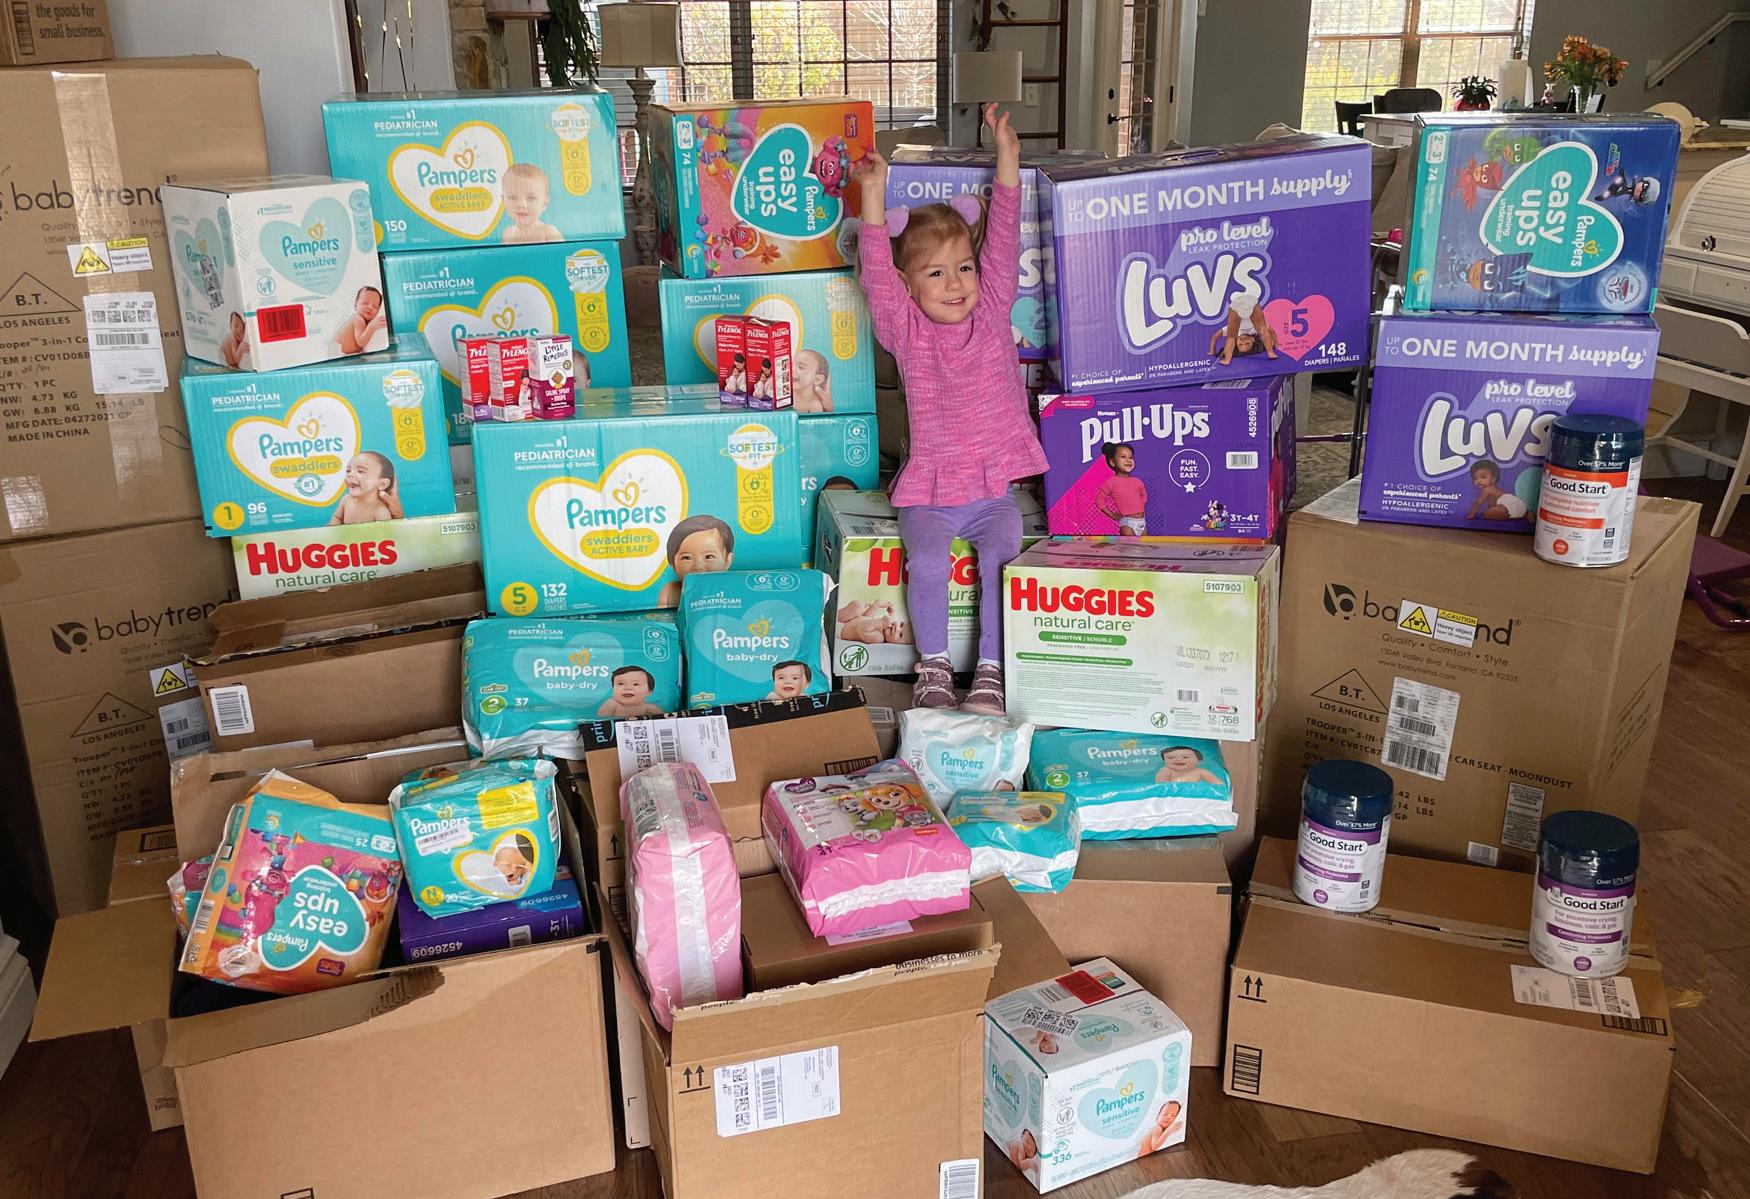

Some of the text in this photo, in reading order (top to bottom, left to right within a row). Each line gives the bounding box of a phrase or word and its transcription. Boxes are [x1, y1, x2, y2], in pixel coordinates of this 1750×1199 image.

[37, 4, 95, 21] the goods for
[39, 25, 63, 39] small
[374, 120, 438, 130] PEDIATRICIAN
[551, 118, 592, 129] SOFTEST
[417, 160, 497, 188] Pampers
[777, 149, 797, 213] easy
[1427, 167, 1438, 181] 74
[758, 166, 777, 217] ups
[893, 181, 905, 189] UP
[907, 182, 953, 199] ONE
[11, 175, 172, 212] babytren
[433, 191, 488, 203] swaddlers
[893, 190, 905, 198] TO
[1087, 193, 1148, 219] ONE
[1158, 179, 1265, 212] MONTH
[439, 200, 487, 210] ACTIVE BABY
[804, 185, 816, 231] Pampers
[1068, 200, 1083, 211] UP
[1540, 170, 1572, 244] easy
[1068, 212, 1084, 222] TO
[1503, 205, 1514, 237] training
[1516, 189, 1543, 247] ups
[384, 220, 407, 232] 150
[1181, 217, 1273, 252] pro level
[1571, 215, 1595, 267] Pampers
[282, 236, 340, 259] Pampers
[1212, 239, 1268, 251] PROTECTION
[293, 256, 337, 269] sensitive
[567, 265, 609, 277] SOFTEST
[403, 278, 474, 292] PEDIATRICIAN
[15, 294, 47, 306] B.T.
[685, 294, 740, 303] PEDIATRICIAN
[0, 316, 71, 329] LOS ANGELES
[1290, 308, 1309, 337] 5
[1387, 337, 1400, 345] UP
[1318, 342, 1347, 358] 148
[1386, 346, 1399, 355] TO
[1402, 338, 1457, 358] ONE
[1465, 341, 1563, 362] MONTH
[1149, 359, 1211, 372] HYPOALLERGENIC
[1304, 357, 1330, 367] DIAPERS
[42, 379, 57, 387] PC
[384, 384, 423, 394] SOFTEST
[1484, 379, 1575, 399] pro level
[63, 391, 78, 399] KG
[212, 393, 280, 405] PEDIATRICIAN
[1515, 397, 1569, 406] PROTECTION
[65, 404, 80, 412] KG
[1248, 398, 1258, 438] 4526908
[8, 427, 90, 442] MADE IN CHINA
[259, 433, 343, 458] Pampers
[729, 441, 777, 455] SOFTEST
[514, 448, 596, 462] PEDIATRICIAN
[748, 452, 762, 460] FIT
[273, 459, 339, 475] swaddlers
[303, 479, 316, 491] #1
[1550, 478, 1606, 494] Good Start
[247, 502, 268, 515] 96
[1382, 499, 1449, 510] HYPOALLERGENIC
[222, 506, 233, 522] 1
[566, 498, 667, 530] Pampers
[443, 523, 477, 533] 5107903
[586, 532, 653, 546] swaddlers
[591, 544, 649, 556] ACTIVE BABY
[246, 540, 398, 576] HUGGIES
[275, 569, 377, 588] natural care
[541, 583, 568, 597] 132
[1205, 583, 1242, 593] 5107903
[512, 586, 527, 605] 5
[1010, 577, 1156, 618] HUGGIES
[690, 598, 742, 608] PEDIATRICIAN
[1034, 615, 1133, 632] natural care
[1446, 613, 1477, 624] CAUTION
[713, 629, 790, 651] Pampers
[1052, 634, 1083, 642] SENSITIVE
[1381, 633, 1510, 666] Quality Comfort Style
[726, 653, 779, 662] baby-dry
[533, 658, 609, 680] Pampers
[546, 681, 598, 690] baby-dry
[1339, 684, 1365, 701] B.T.
[514, 697, 528, 707] 37
[98, 709, 126, 722] B.T.
[1319, 701, 1380, 724] LOS ANGELES
[1220, 715, 1239, 725] 768
[82, 725, 147, 745] LOS ANGELES
[1305, 729, 1328, 743] ITEM
[941, 751, 984, 770] Pampers
[1087, 745, 1158, 763] Pampers
[1102, 757, 1149, 767] baby-dry
[945, 769, 979, 779] sensitive
[1053, 773, 1062, 783] 2
[1454, 755, 1574, 790] CAR SEAT MOONDUST
[1418, 795, 1436, 806] LBS
[1394, 812, 1408, 821] GP
[1416, 807, 1434, 817] LBS
[410, 816, 470, 836] Pampers
[1309, 832, 1363, 852] Good Start
[294, 892, 340, 915] ups
[1564, 896, 1624, 911] Good Start
[290, 910, 348, 937] easy
[266, 932, 309, 951] Pampers
[412, 941, 463, 959] 4526609
[896, 949, 983, 969] businesses to more
[1080, 1023, 1120, 1039] Pampers
[992, 1064, 1020, 1105] Pampers
[1096, 1090, 1145, 1117] Pampers
[1102, 1106, 1141, 1125] sensitive
[1052, 1153, 1072, 1166] 336
